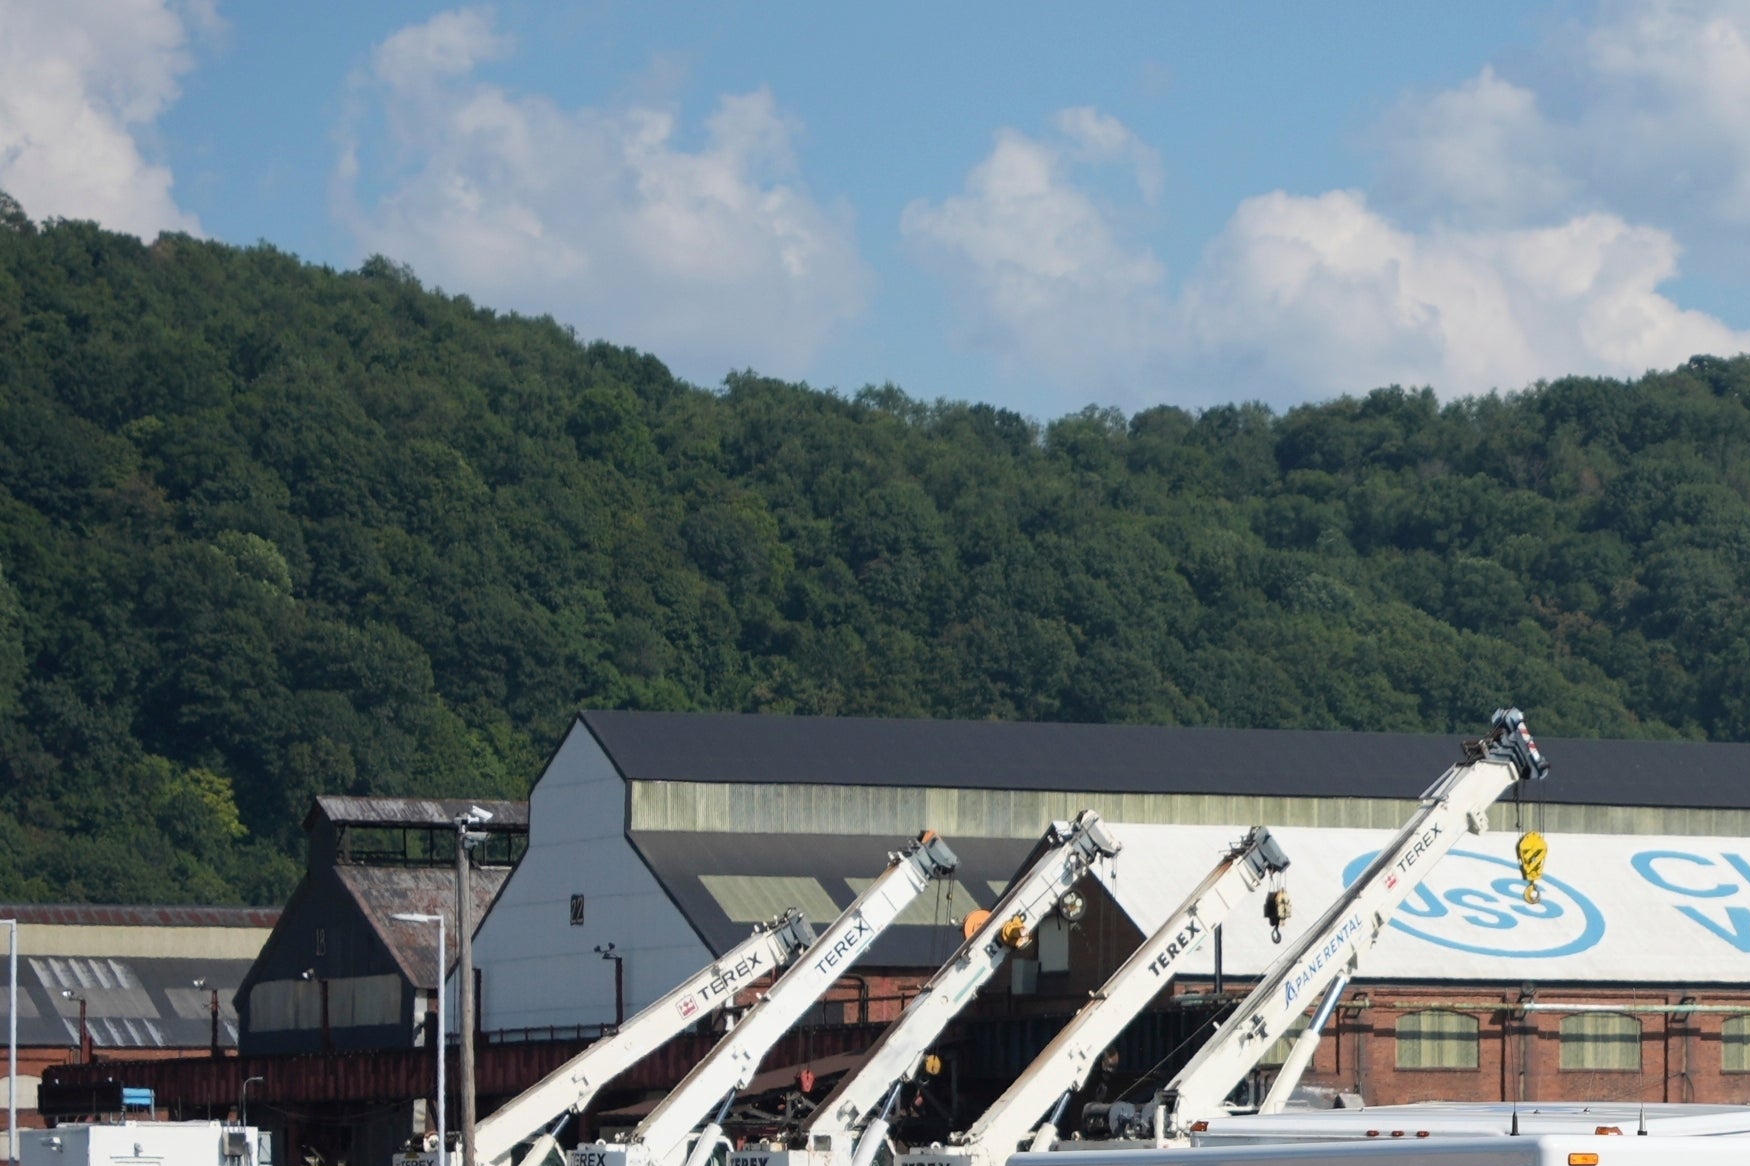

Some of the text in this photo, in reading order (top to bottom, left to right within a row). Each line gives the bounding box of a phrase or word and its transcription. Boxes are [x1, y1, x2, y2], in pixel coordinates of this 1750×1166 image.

[1396, 822, 1443, 873] TEREX
[815, 919, 870, 975] TEREX
[1147, 921, 1203, 977] TEREX
[1323, 914, 1362, 961] RENTAL
[698, 952, 762, 1001] TEREX
